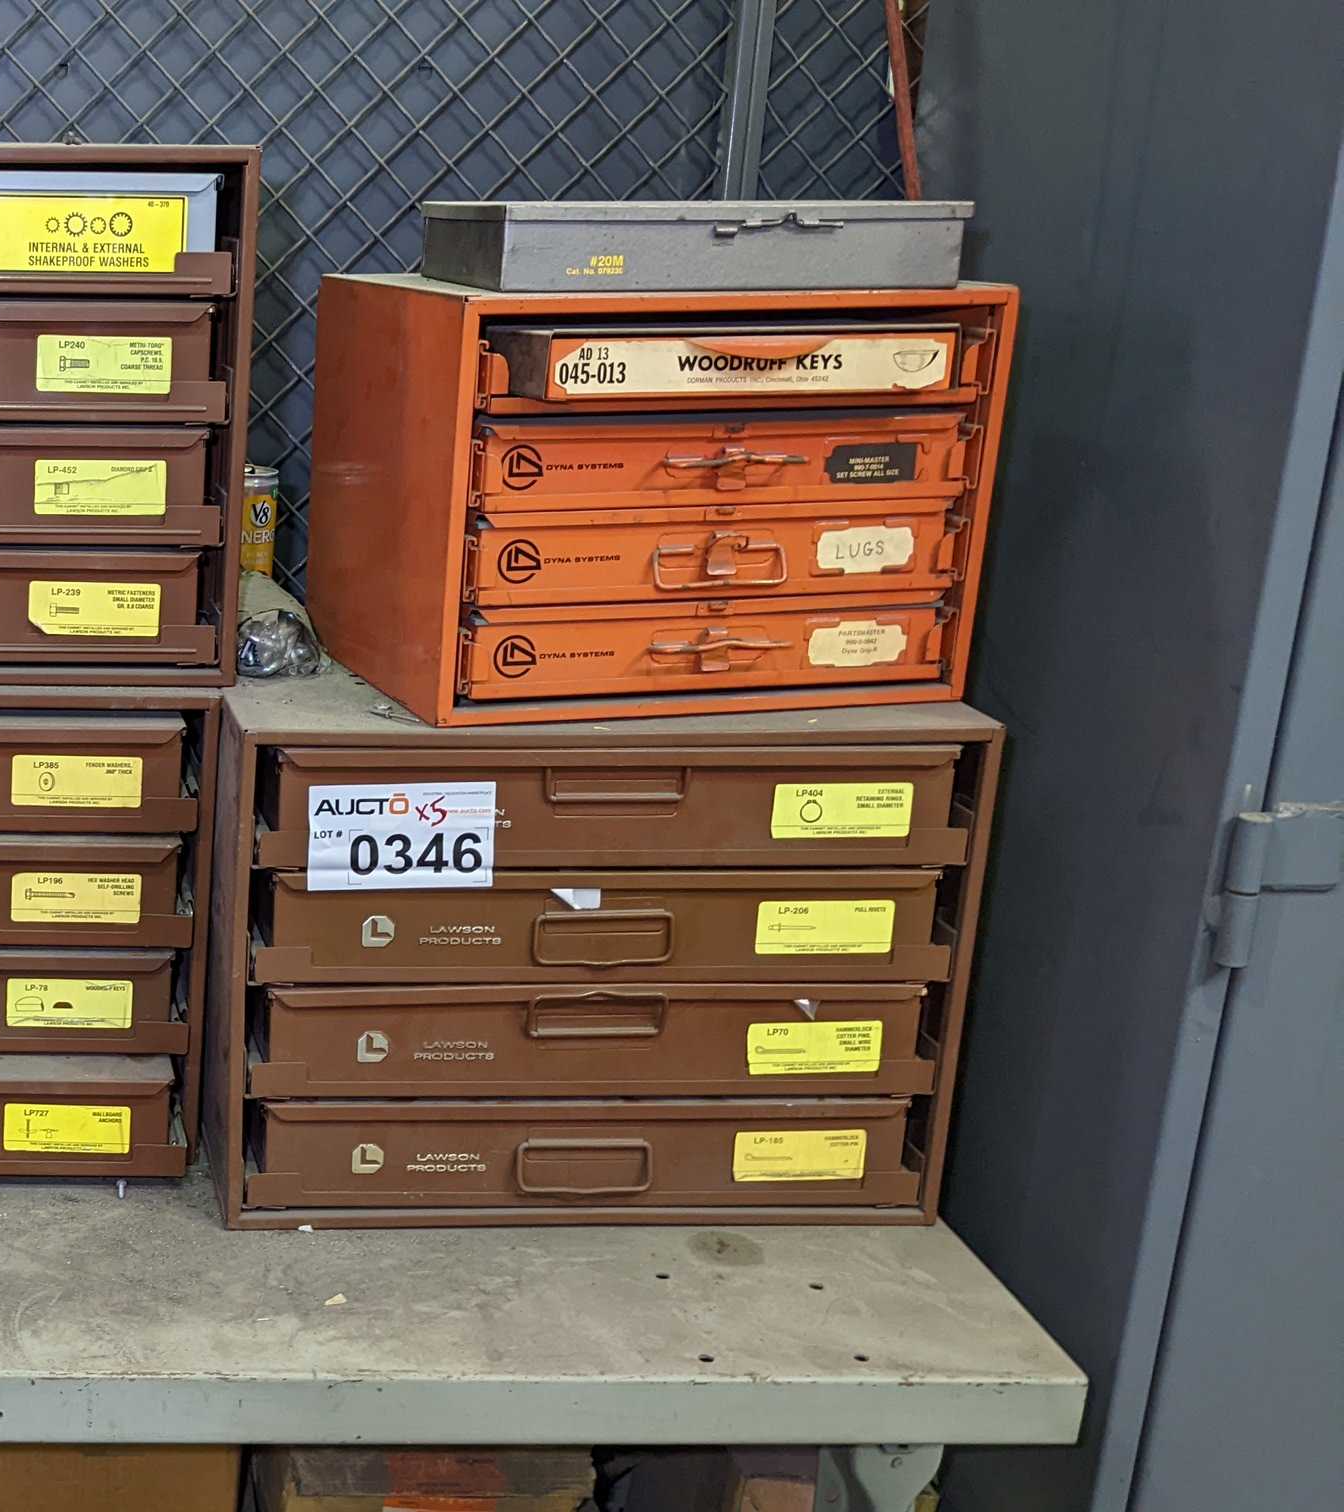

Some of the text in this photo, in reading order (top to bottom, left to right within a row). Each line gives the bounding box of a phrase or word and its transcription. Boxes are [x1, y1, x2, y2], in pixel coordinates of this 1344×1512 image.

[28, 242, 145, 254] INTERNAL & EXTERNAL
[28, 255, 150, 268] SHAKEPROOF WASHERS
[591, 254, 624, 266] #20M
[58, 340, 86, 349] LP240
[578, 347, 609, 361] AD 13
[678, 354, 843, 372] WOODRUFF KEYS
[559, 362, 627, 385] 045-013
[47, 466, 77, 474] LP-452
[251, 500, 270, 525] V8
[835, 540, 885, 560] LUGS
[575, 555, 621, 563] SYSTEMS
[51, 588, 81, 596] LP-239
[539, 650, 615, 660] DYNA SYSTEMS
[796, 789, 824, 798] LP404
[313, 830, 343, 840] LOT #
[349, 832, 484, 876] 0346
[37, 877, 63, 885] LP196
[429, 925, 496, 934] LAWSON
[419, 937, 502, 945] PRODUCTS
[767, 1028, 789, 1036] LP70
[422, 1040, 489, 1049] LAWSON
[414, 1052, 496, 1061] PRODUCTS
[23, 1109, 49, 1117] LP727
[416, 1153, 481, 1161] LAWSON
[406, 1164, 487, 1172] PRODUCTS
